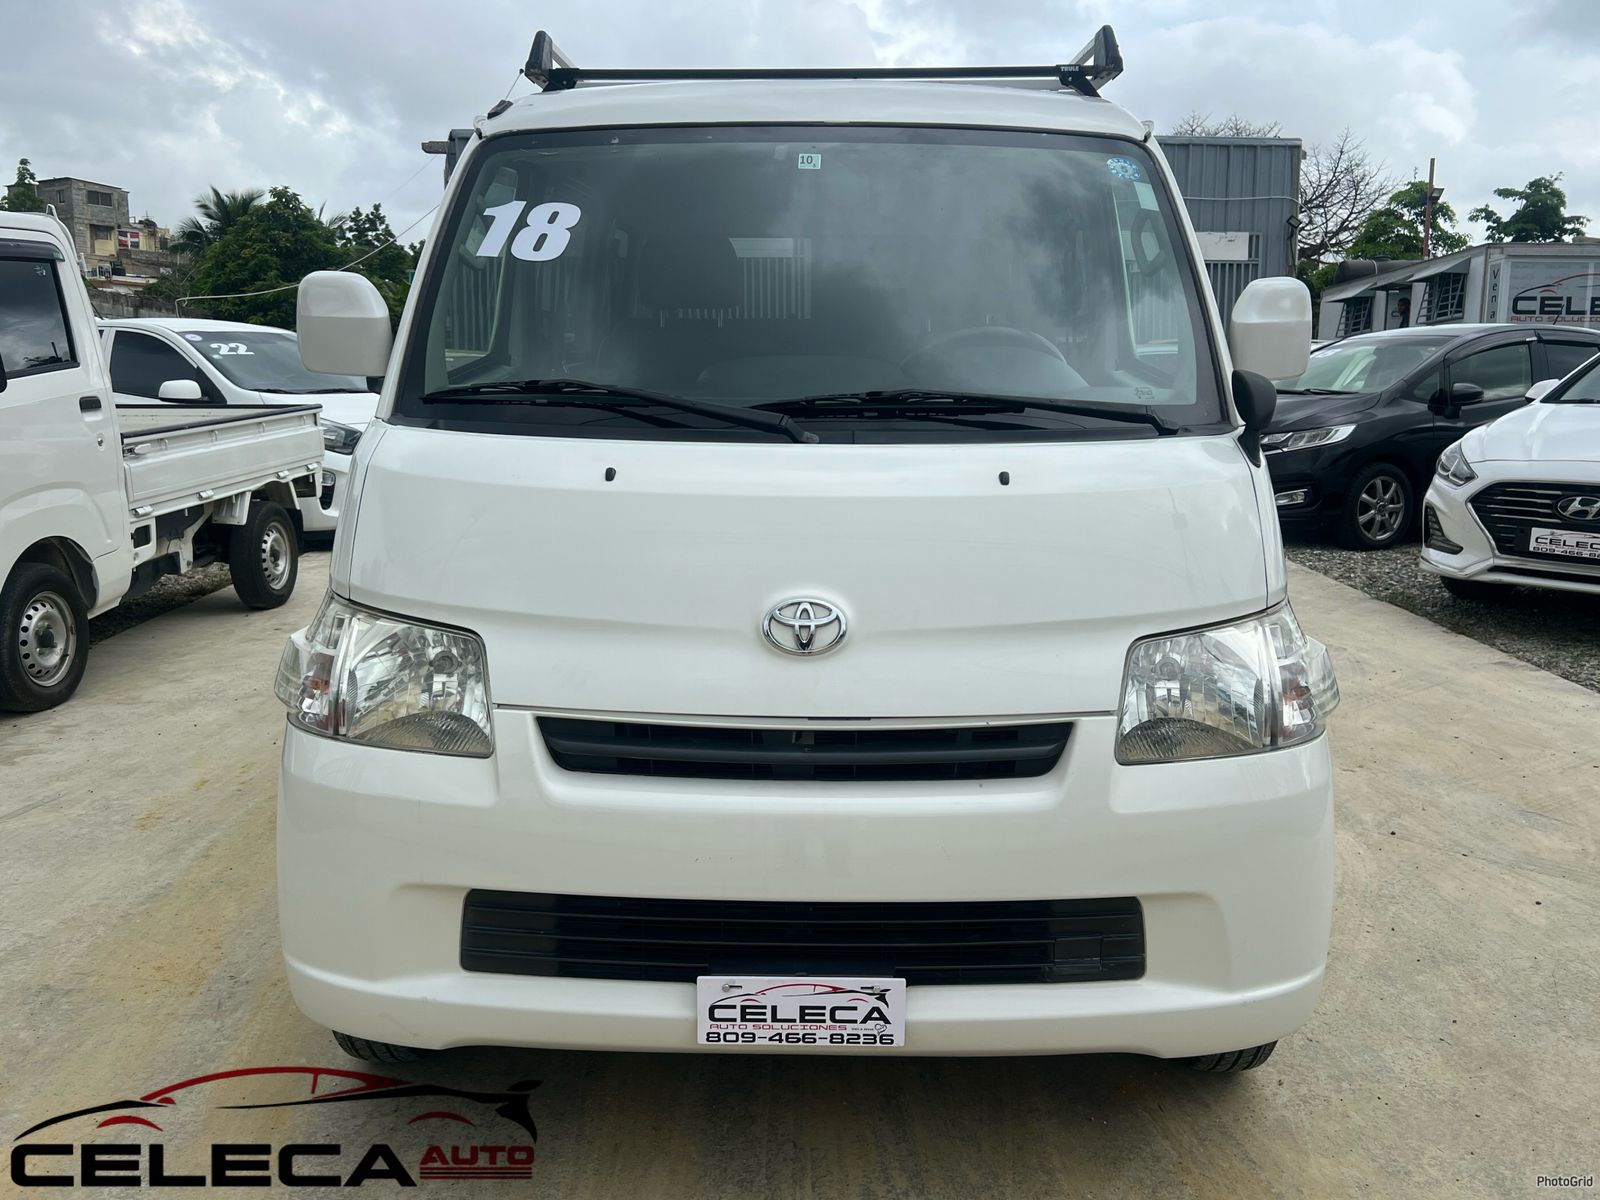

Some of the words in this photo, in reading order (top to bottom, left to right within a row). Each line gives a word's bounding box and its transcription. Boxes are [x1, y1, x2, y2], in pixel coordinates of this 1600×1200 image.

[800, 155, 814, 165] 10
[475, 200, 582, 262] 18
[1511, 315, 1543, 323] AUTO
[209, 342, 255, 355] 22
[708, 1004, 892, 1025] CELECA
[709, 1023, 748, 1031] AUTO
[752, 1023, 848, 1031] SOLUCIONES
[705, 1031, 895, 1046] 809-466-8236
